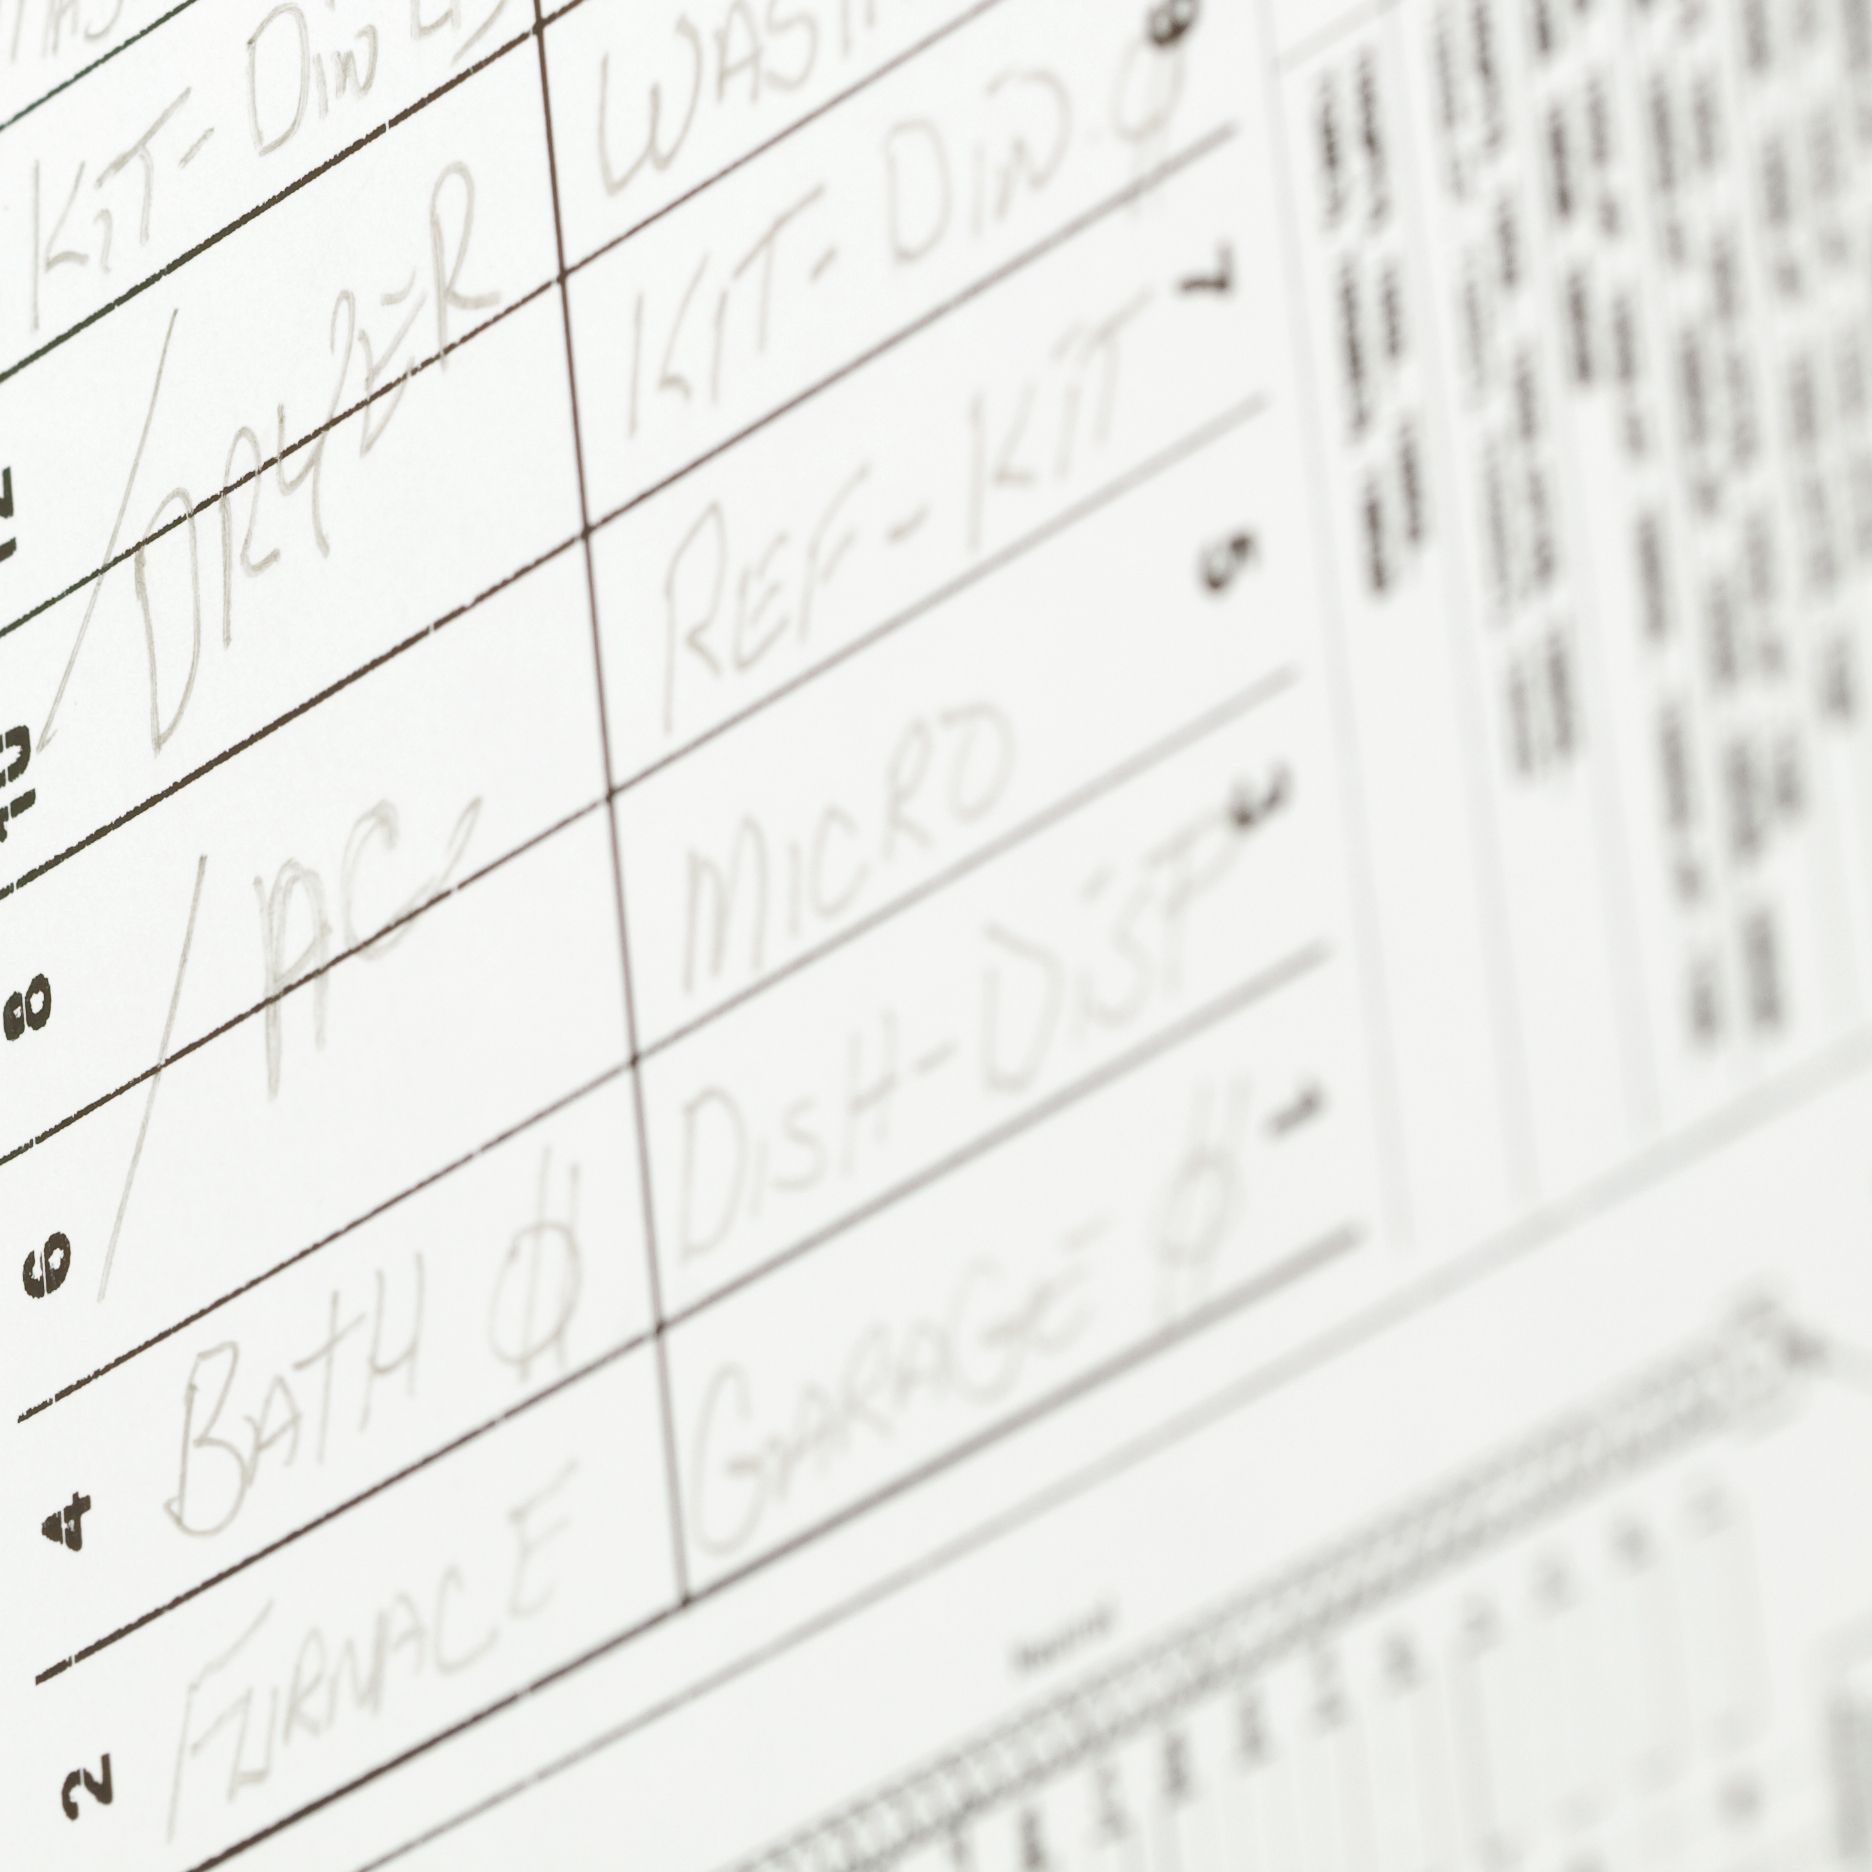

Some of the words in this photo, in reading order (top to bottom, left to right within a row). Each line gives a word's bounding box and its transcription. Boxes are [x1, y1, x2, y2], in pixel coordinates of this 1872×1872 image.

[1175, 236, 1237, 296] 7
[2, 973, 52, 1041] 8
[22, 1232, 71, 1300] 6
[164, 1251, 426, 1537] BATH
[40, 1491, 91, 1552] 4
[165, 1457, 582, 1846] FURNACE
[61, 1753, 113, 1820] 2
